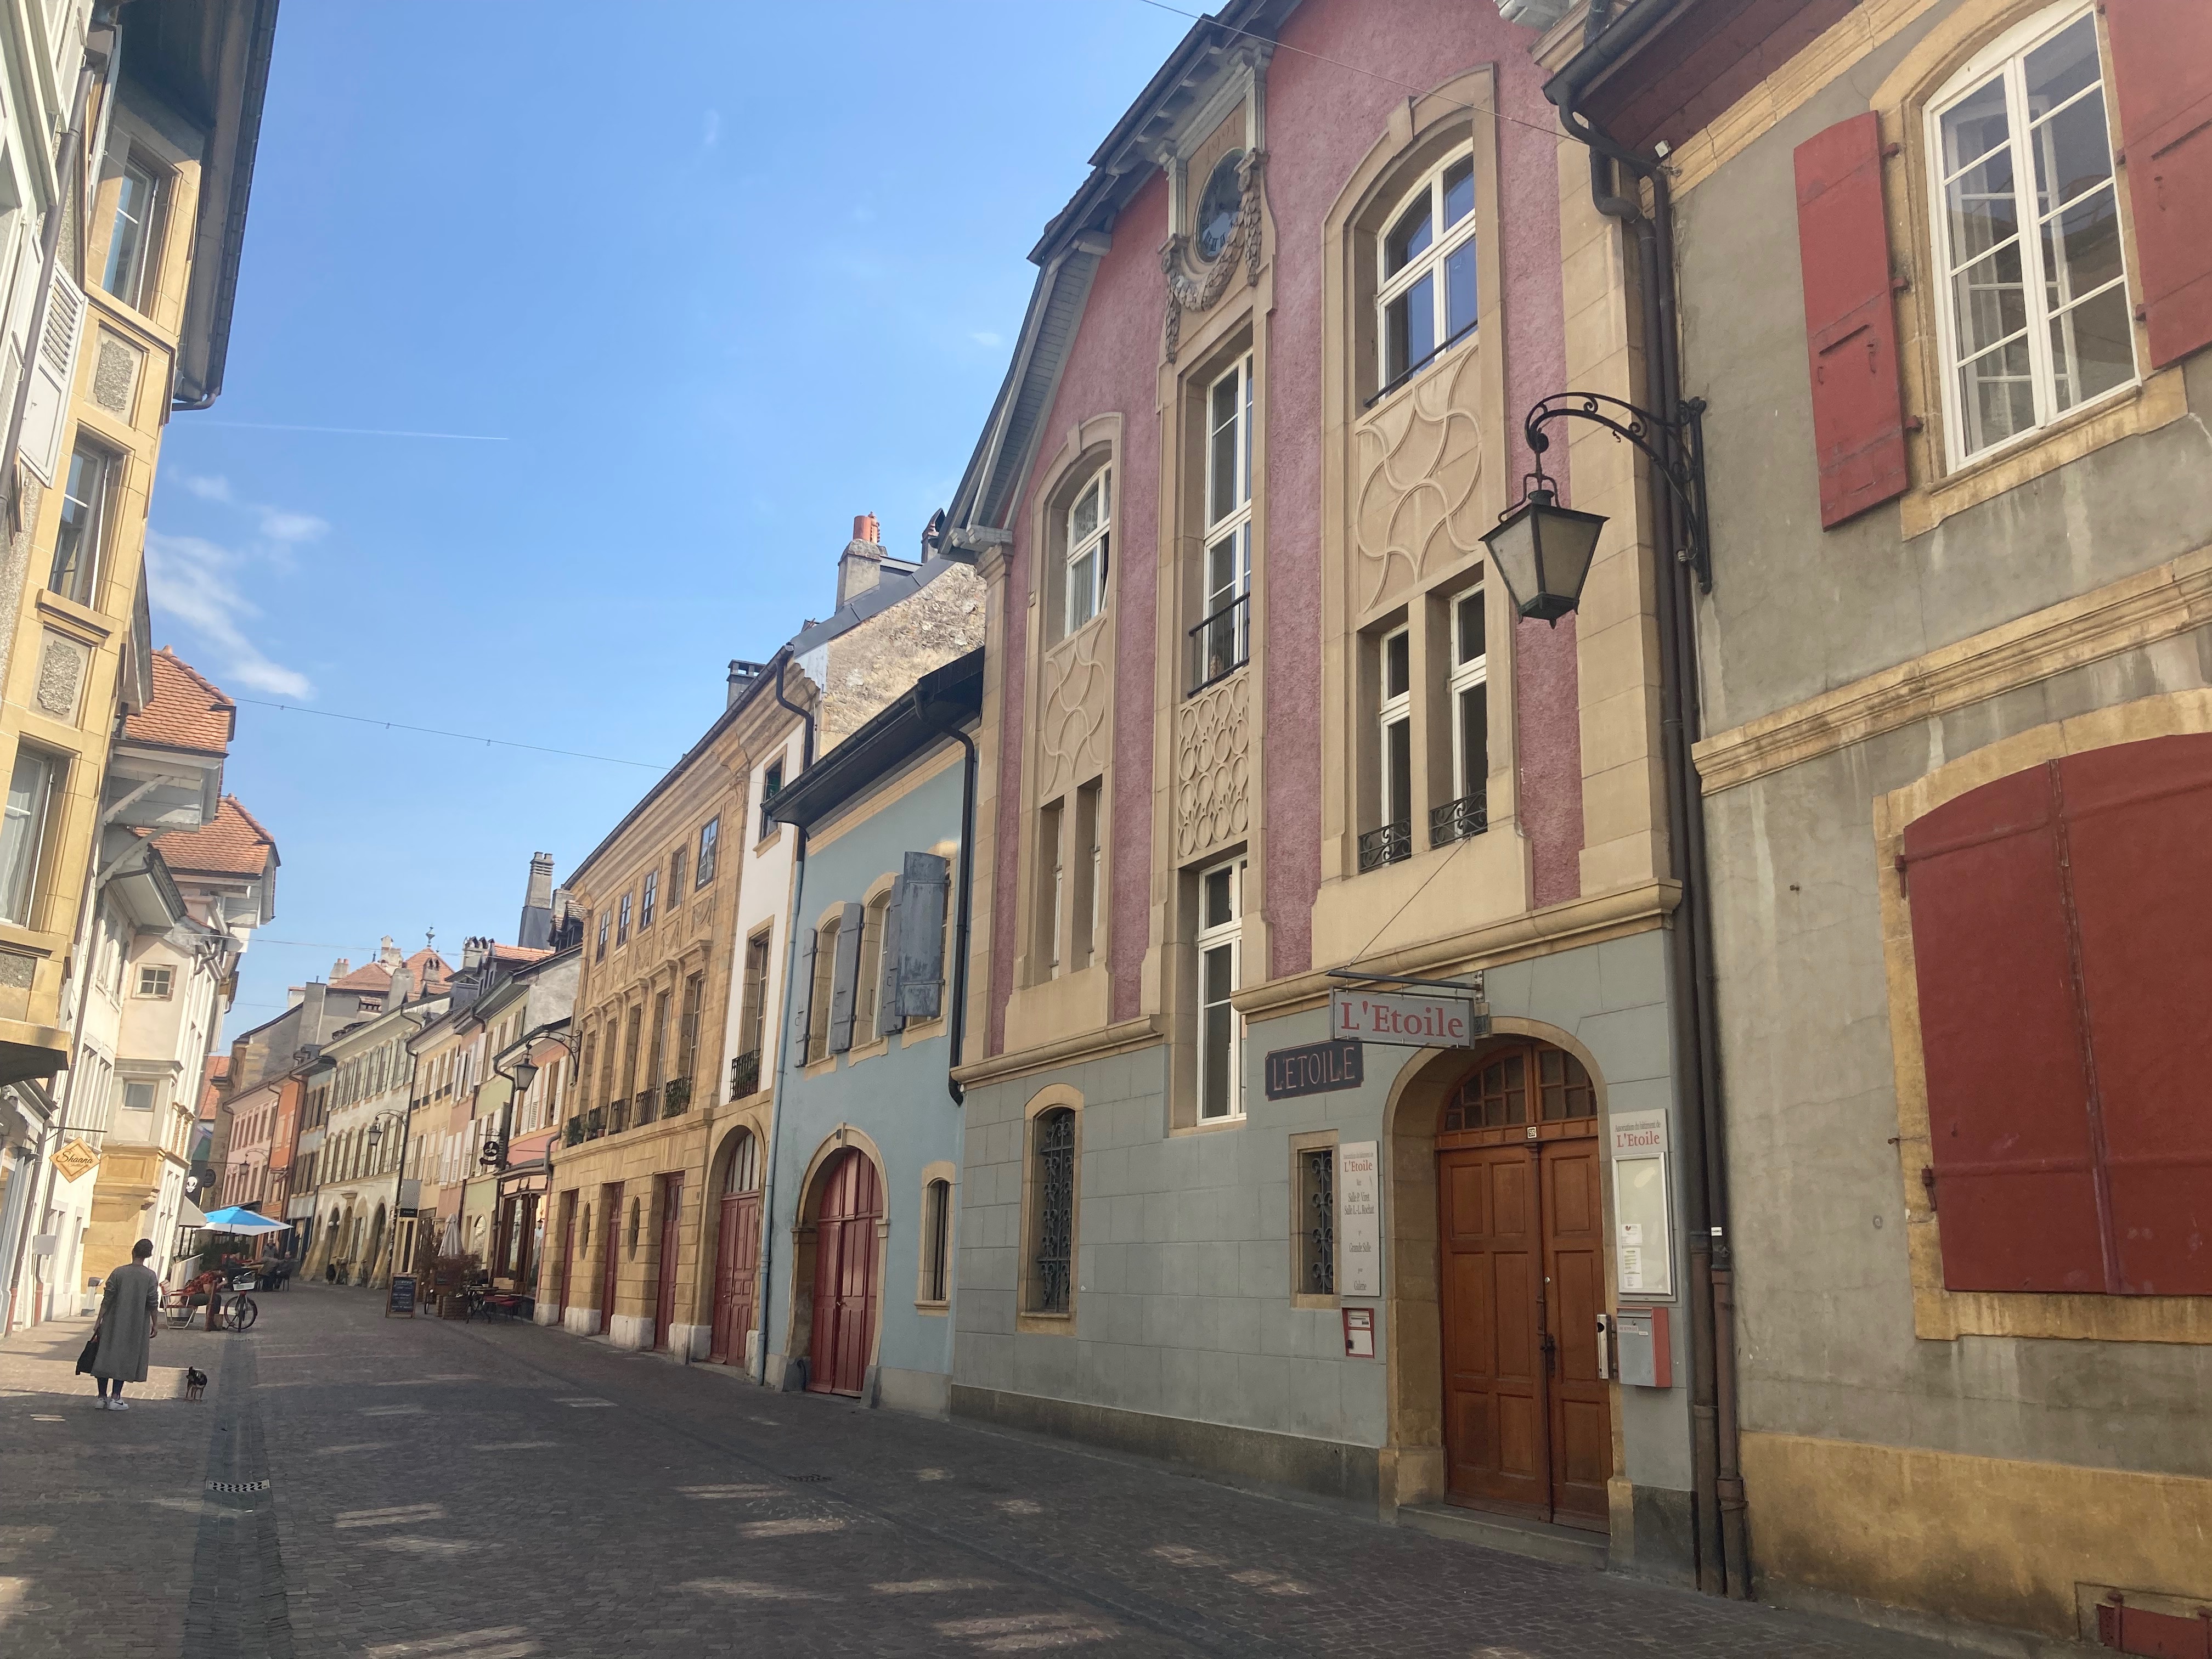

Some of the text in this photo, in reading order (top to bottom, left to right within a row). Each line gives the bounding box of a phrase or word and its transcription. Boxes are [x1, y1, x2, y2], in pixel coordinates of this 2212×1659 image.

[1340, 1000, 1464, 1038] L'Etoile
[1616, 1131, 1660, 1148] L'Etoile
[1344, 1159, 1373, 1172] L'Etoile
